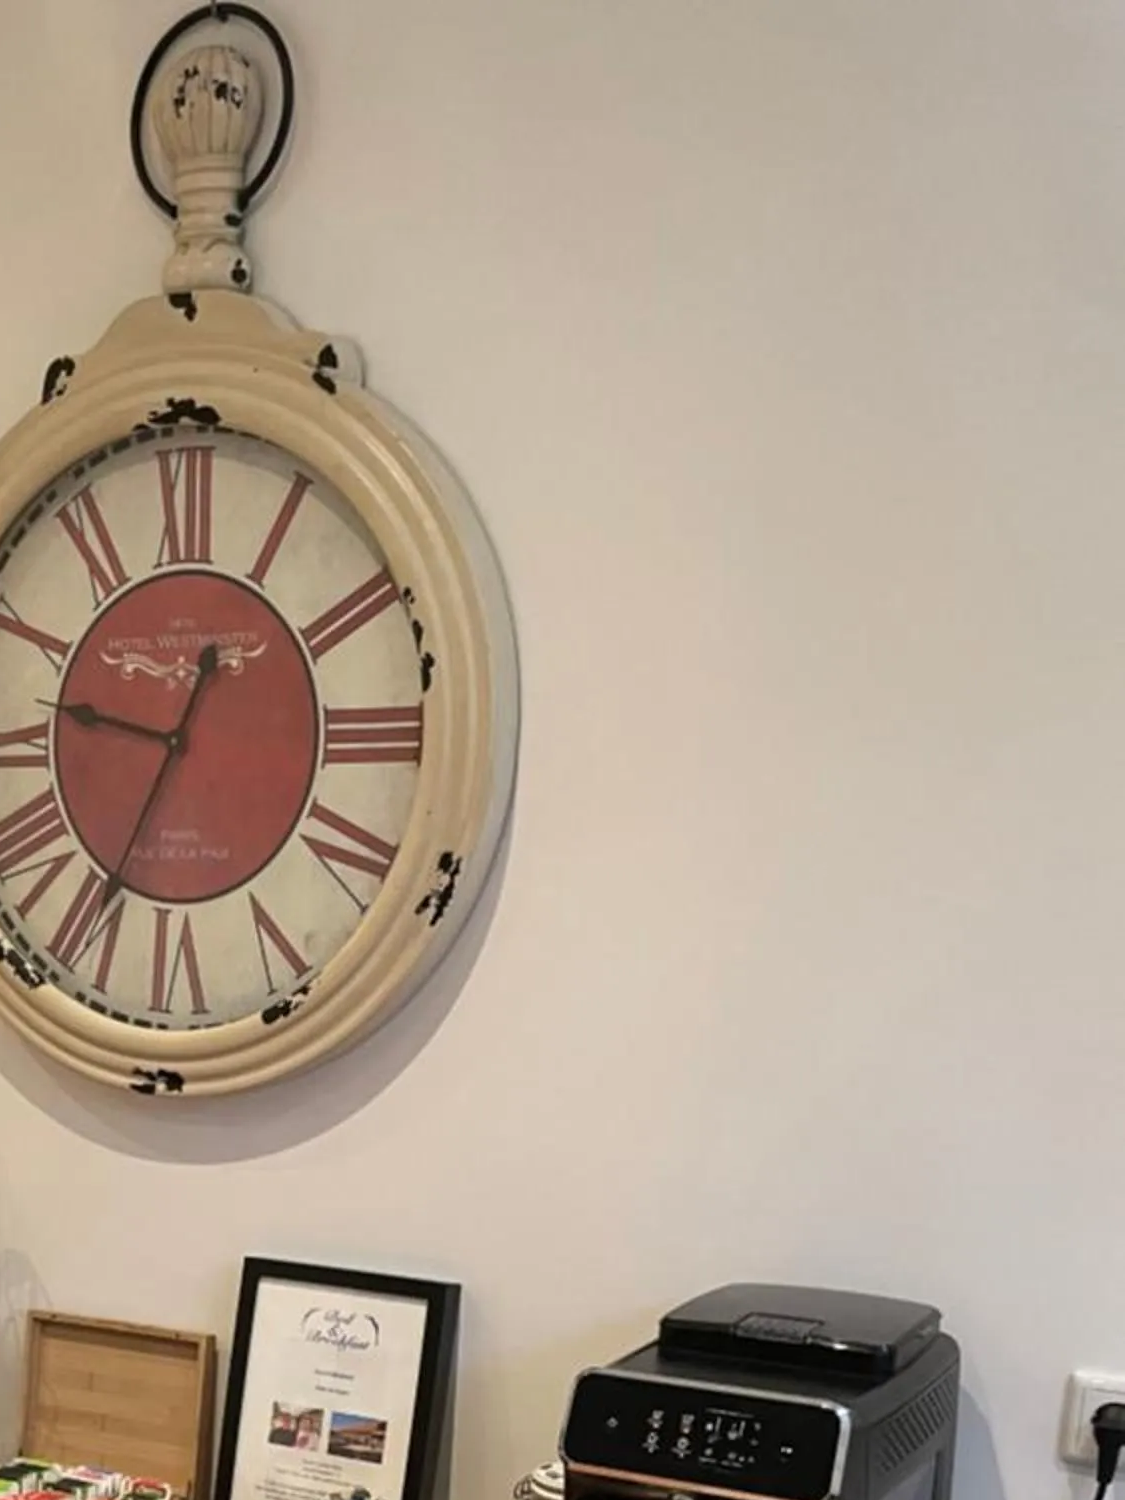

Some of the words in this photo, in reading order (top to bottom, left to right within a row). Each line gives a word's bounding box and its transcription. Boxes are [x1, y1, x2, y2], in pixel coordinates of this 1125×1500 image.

[54, 482, 131, 612] XI
[153, 446, 216, 569] XII
[245, 470, 313, 589] I
[108, 637, 155, 650] HOTEL
[298, 563, 402, 664] II
[322, 701, 423, 768] III
[298, 797, 401, 916] IV
[149, 906, 210, 1015] VI
[248, 890, 313, 996] V
